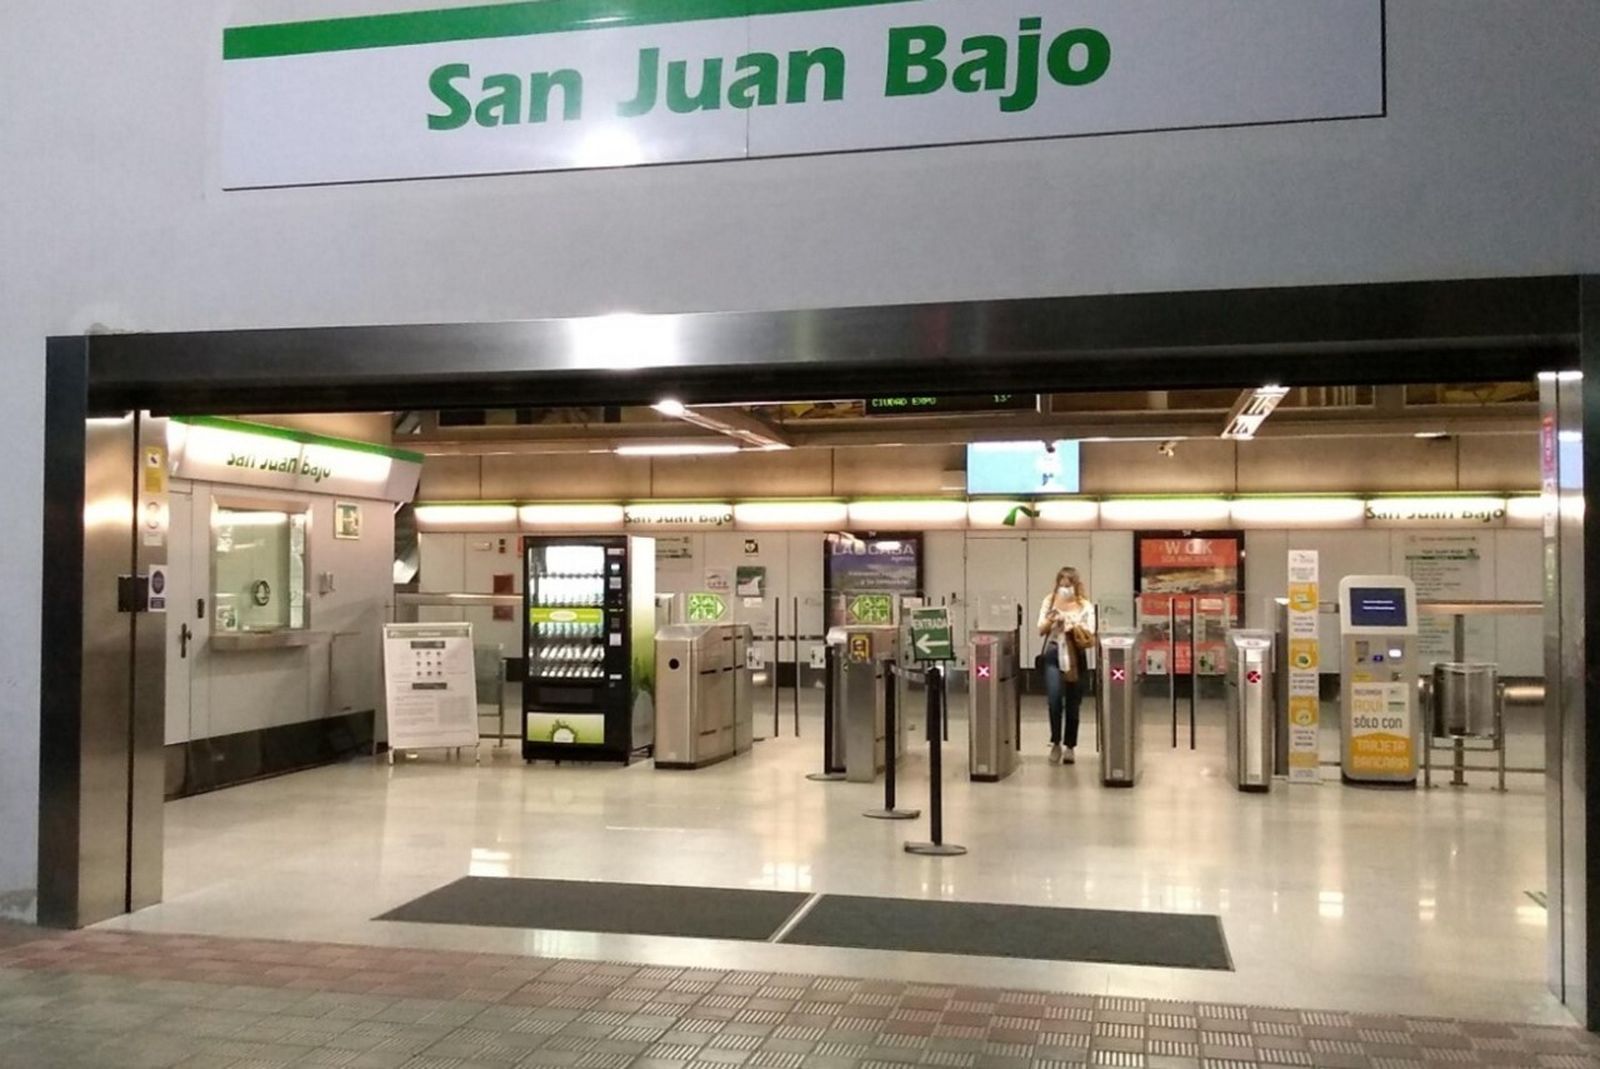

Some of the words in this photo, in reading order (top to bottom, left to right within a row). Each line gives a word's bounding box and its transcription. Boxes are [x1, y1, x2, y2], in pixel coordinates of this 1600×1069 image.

[427, 62, 583, 131] San
[616, 47, 846, 118] Juan
[884, 17, 1111, 113] Bajo
